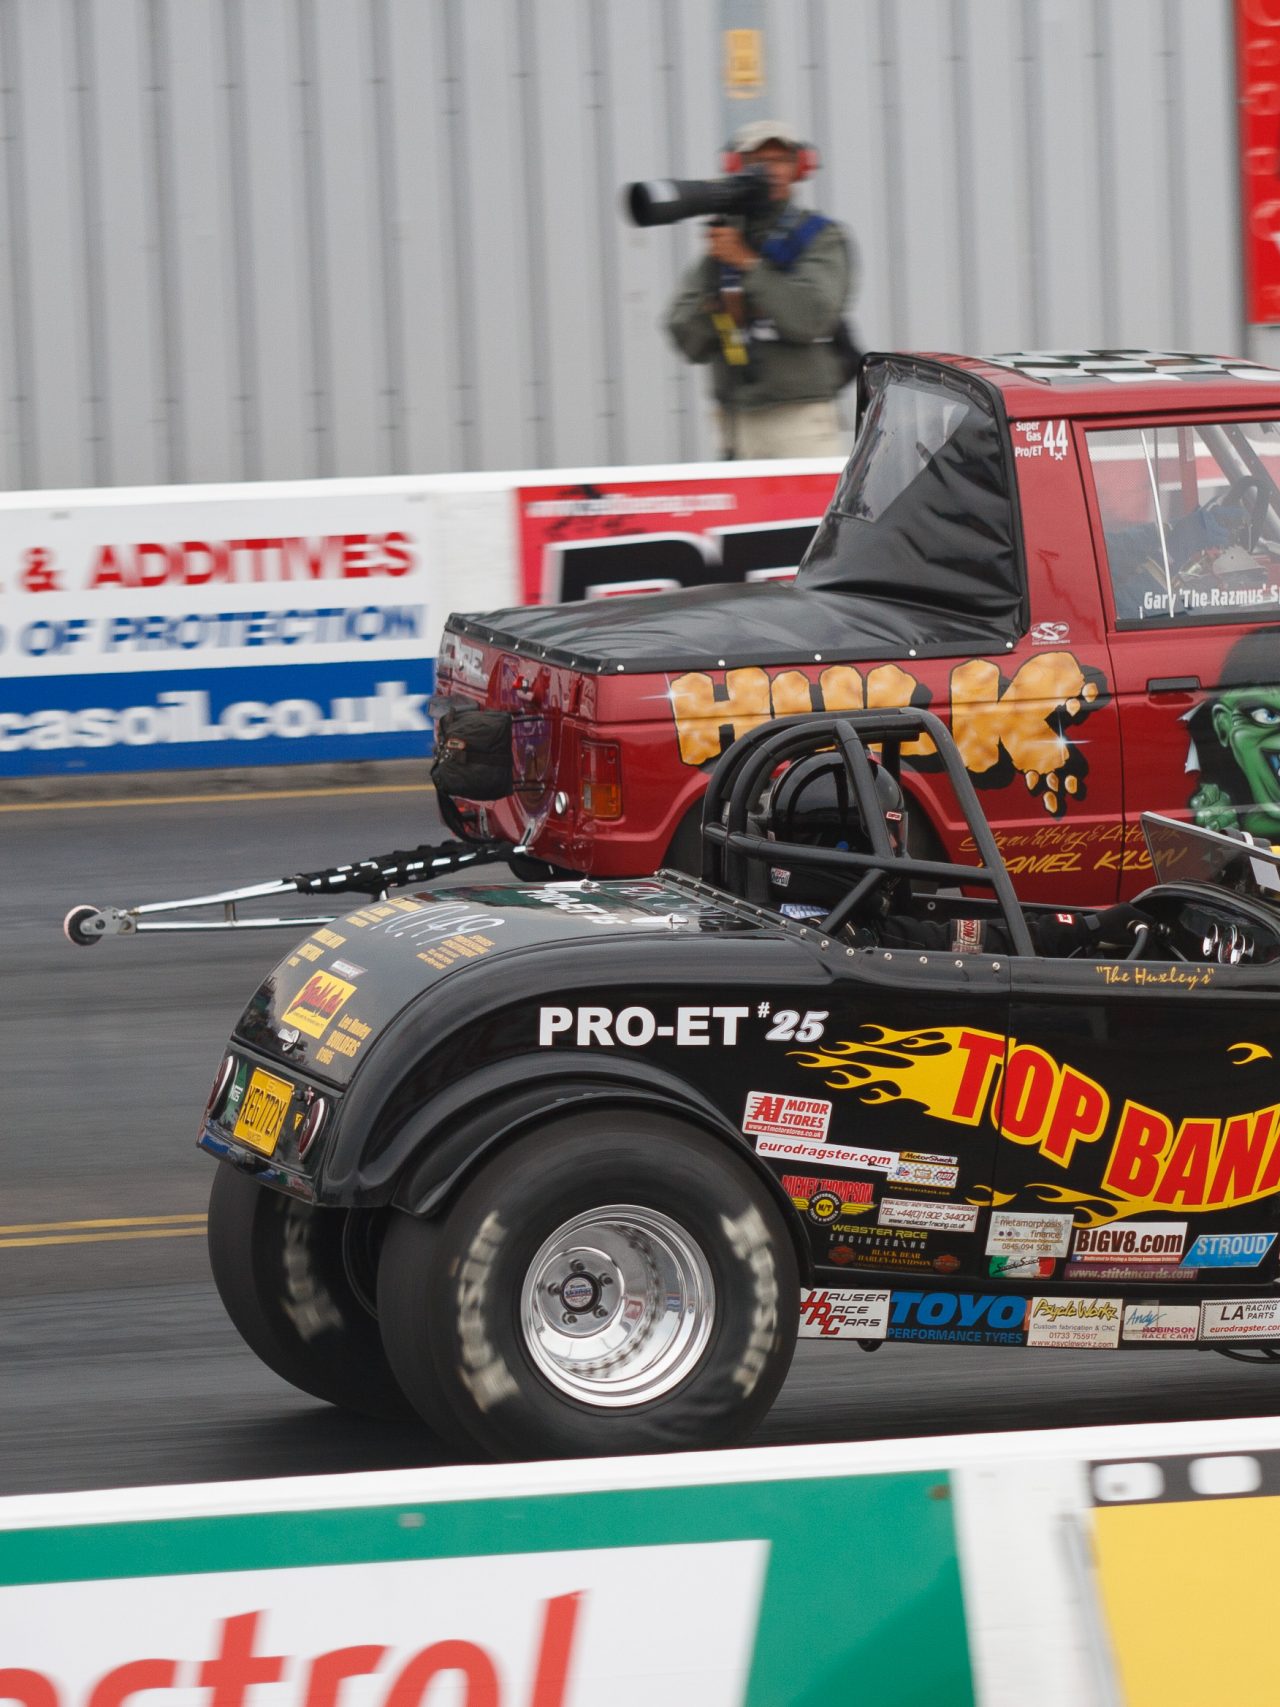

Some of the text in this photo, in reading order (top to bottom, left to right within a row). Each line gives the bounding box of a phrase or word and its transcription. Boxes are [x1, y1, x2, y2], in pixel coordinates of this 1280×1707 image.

[1026, 431, 1041, 442] Gas
[1044, 419, 1068, 457] 44
[1015, 446, 1043, 458] Pro/ET
[19, 531, 420, 592] & ADDITIVES
[1144, 591, 1176, 609] Gary
[1179, 588, 1208, 608] 'The
[19, 603, 428, 657] OF PROTECTION
[539, 1005, 749, 1047] PRO-ET
[948, 1028, 1107, 1167] TOP
[784, 1099, 830, 1116] MOTOR
[780, 1113, 825, 1129] STORES
[758, 1140, 892, 1167] eurodragster.com
[781, 1174, 875, 1205] MICKEY THOMPSON
[1000, 1219, 1062, 1230] metamorphosis
[829, 1232, 927, 1250] ENGINEERING
[1076, 1229, 1184, 1255] BIGV8.com
[1196, 1236, 1268, 1257] STROUD
[890, 1291, 1028, 1329] TOYO
[1220, 1303, 1278, 1321] LA RACING
[1247, 1311, 1275, 1320] PARTS
[887, 1328, 1023, 1344] PERFORMANCE TYRES
[1049, 1331, 1098, 1341] 01733 755917
[1059, 1324, 1092, 1332] fabrication
[1101, 1324, 1116, 1332] CNC
